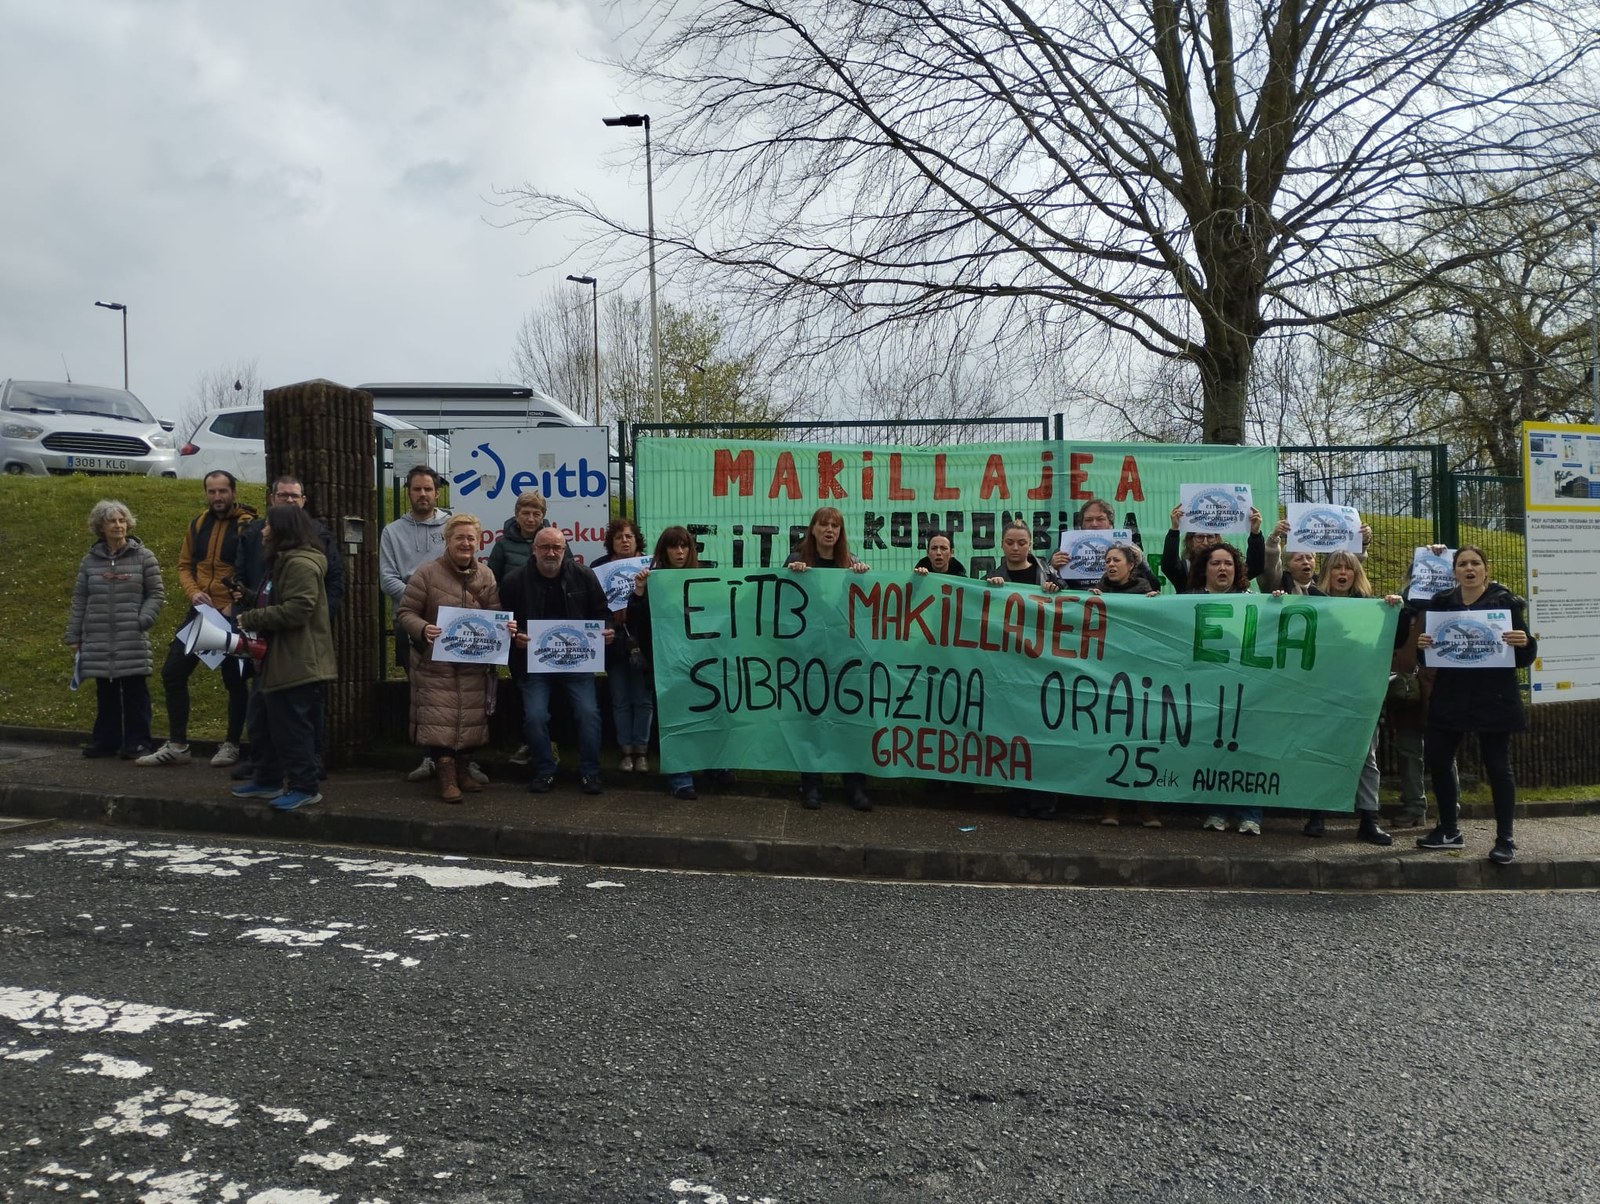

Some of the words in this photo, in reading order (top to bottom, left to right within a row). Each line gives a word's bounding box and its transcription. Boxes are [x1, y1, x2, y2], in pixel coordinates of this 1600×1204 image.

[75, 458, 101, 468] 3081
[106, 460, 126, 469] KLG
[511, 458, 607, 498] eitb
[1193, 603, 1318, 671] ELA
[871, 726, 1032, 782] GREBARA
[1193, 768, 1280, 795] AURRERA
